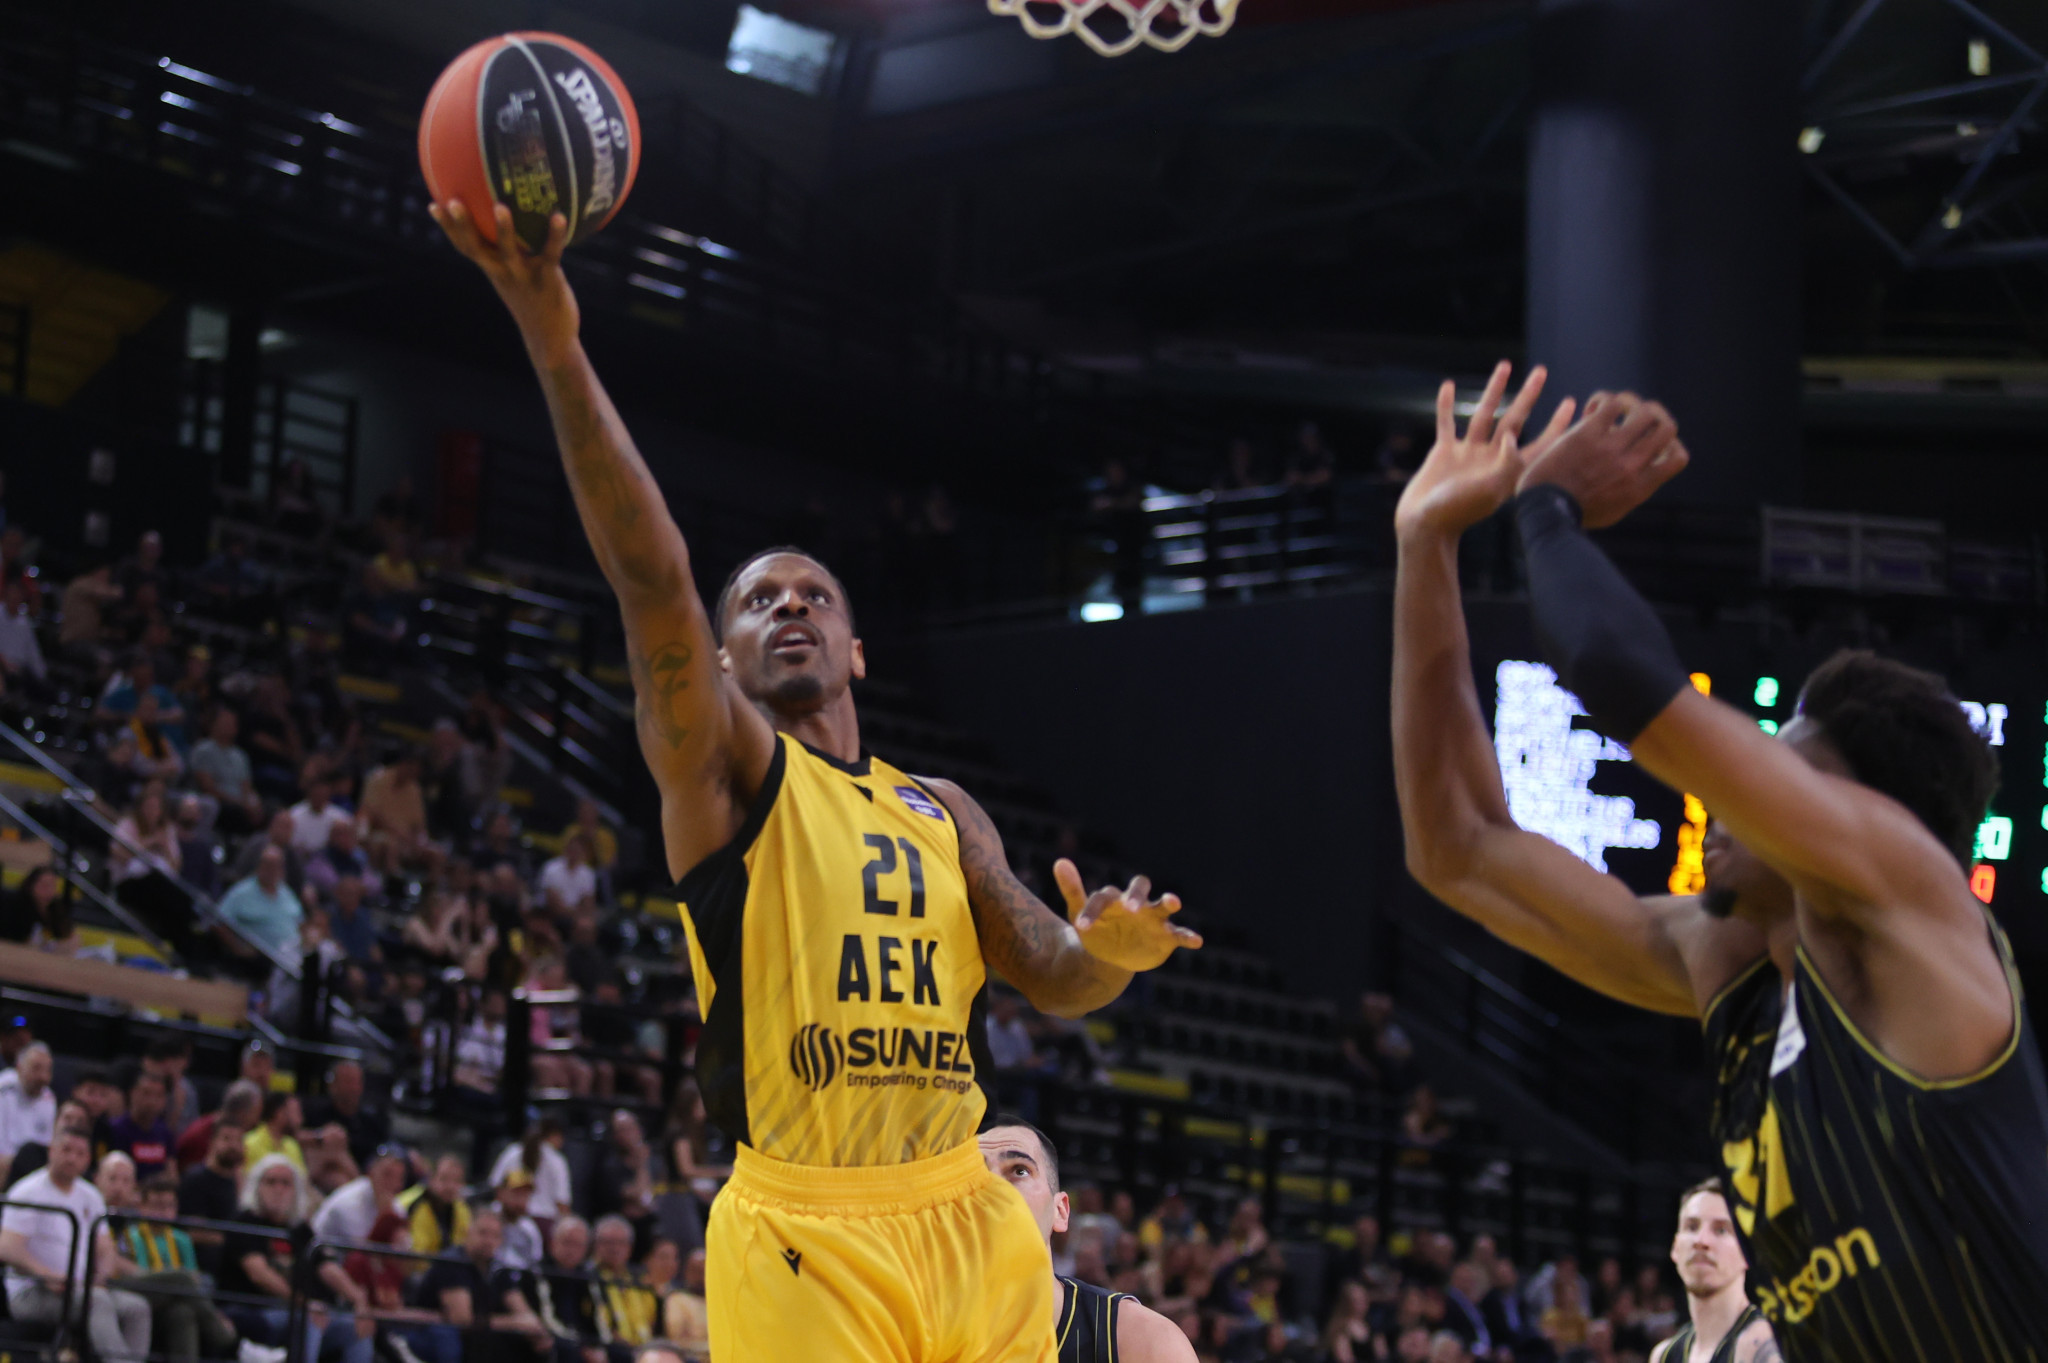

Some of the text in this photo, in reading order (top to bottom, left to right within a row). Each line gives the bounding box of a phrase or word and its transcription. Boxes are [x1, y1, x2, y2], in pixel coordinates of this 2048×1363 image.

[861, 832, 926, 918] 21
[837, 934, 941, 1006] AEK
[847, 1027, 971, 1074] SUNEL
